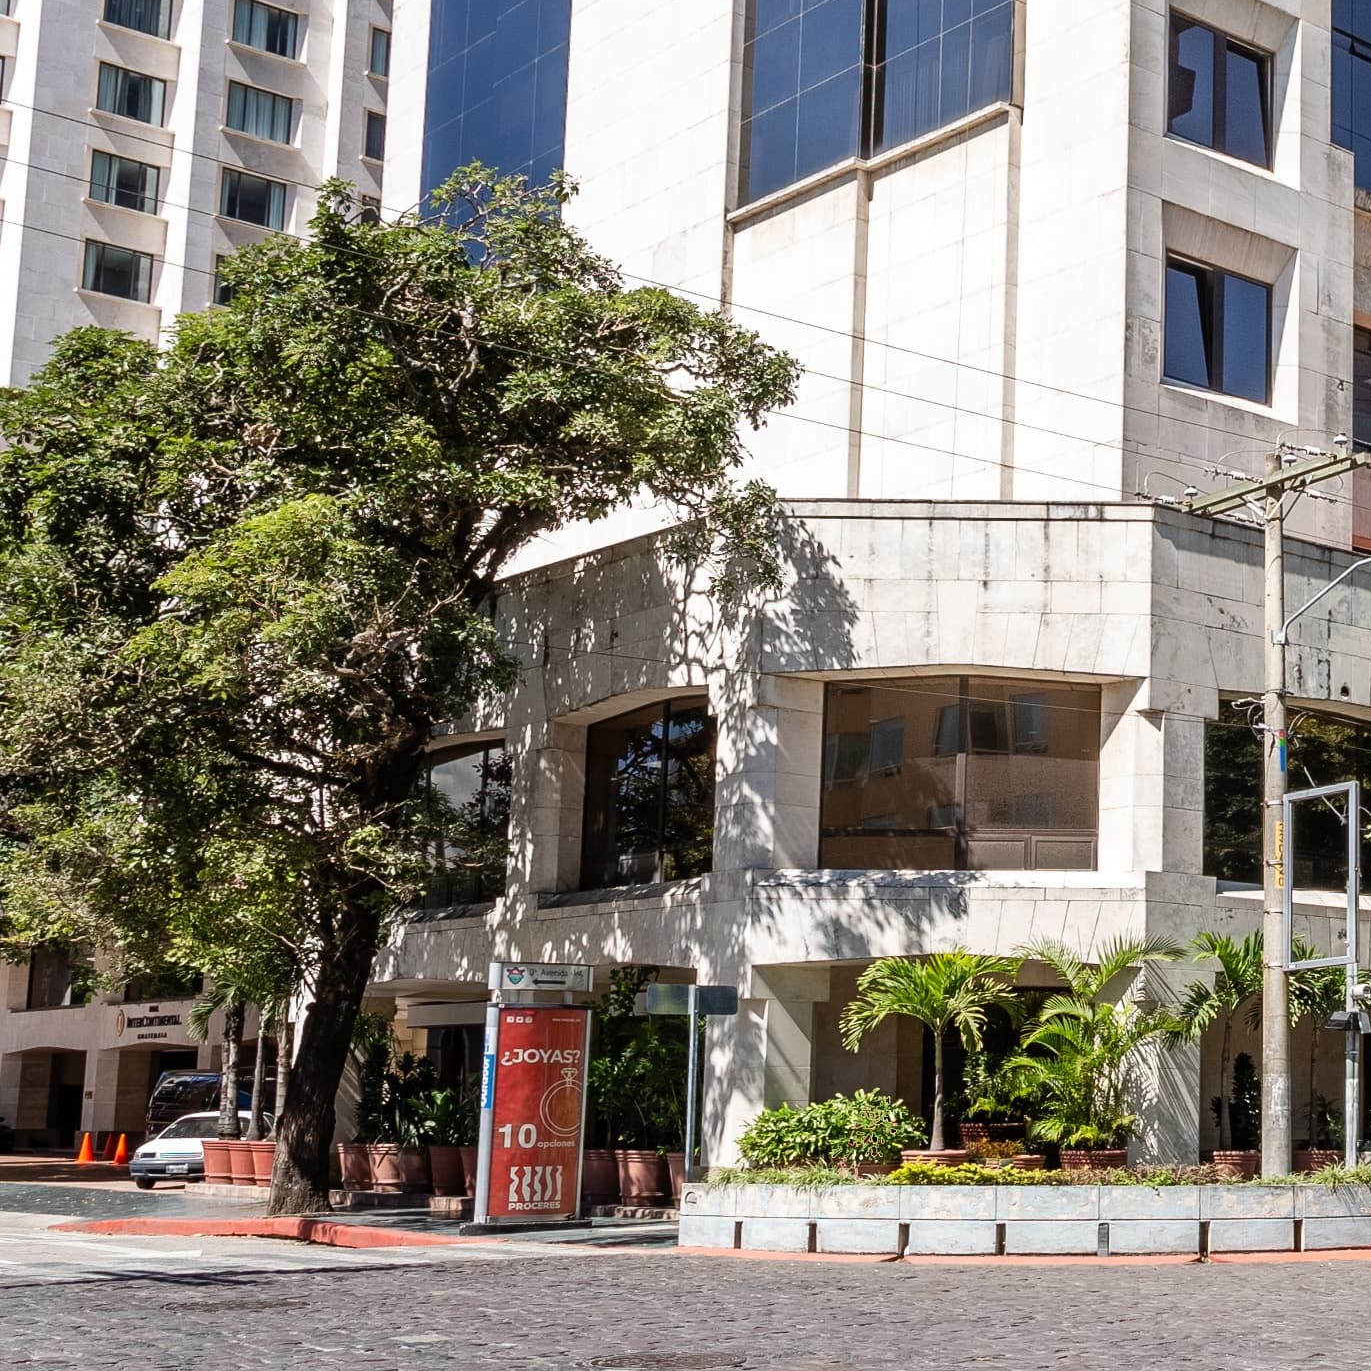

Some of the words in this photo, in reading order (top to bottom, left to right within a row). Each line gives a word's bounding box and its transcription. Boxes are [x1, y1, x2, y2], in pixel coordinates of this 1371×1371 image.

[501, 1049, 581, 1066] ¿JOYAS?
[497, 1123, 538, 1149] 10
[536, 1139, 576, 1149] opciones
[508, 1201, 562, 1212] PROCERES
